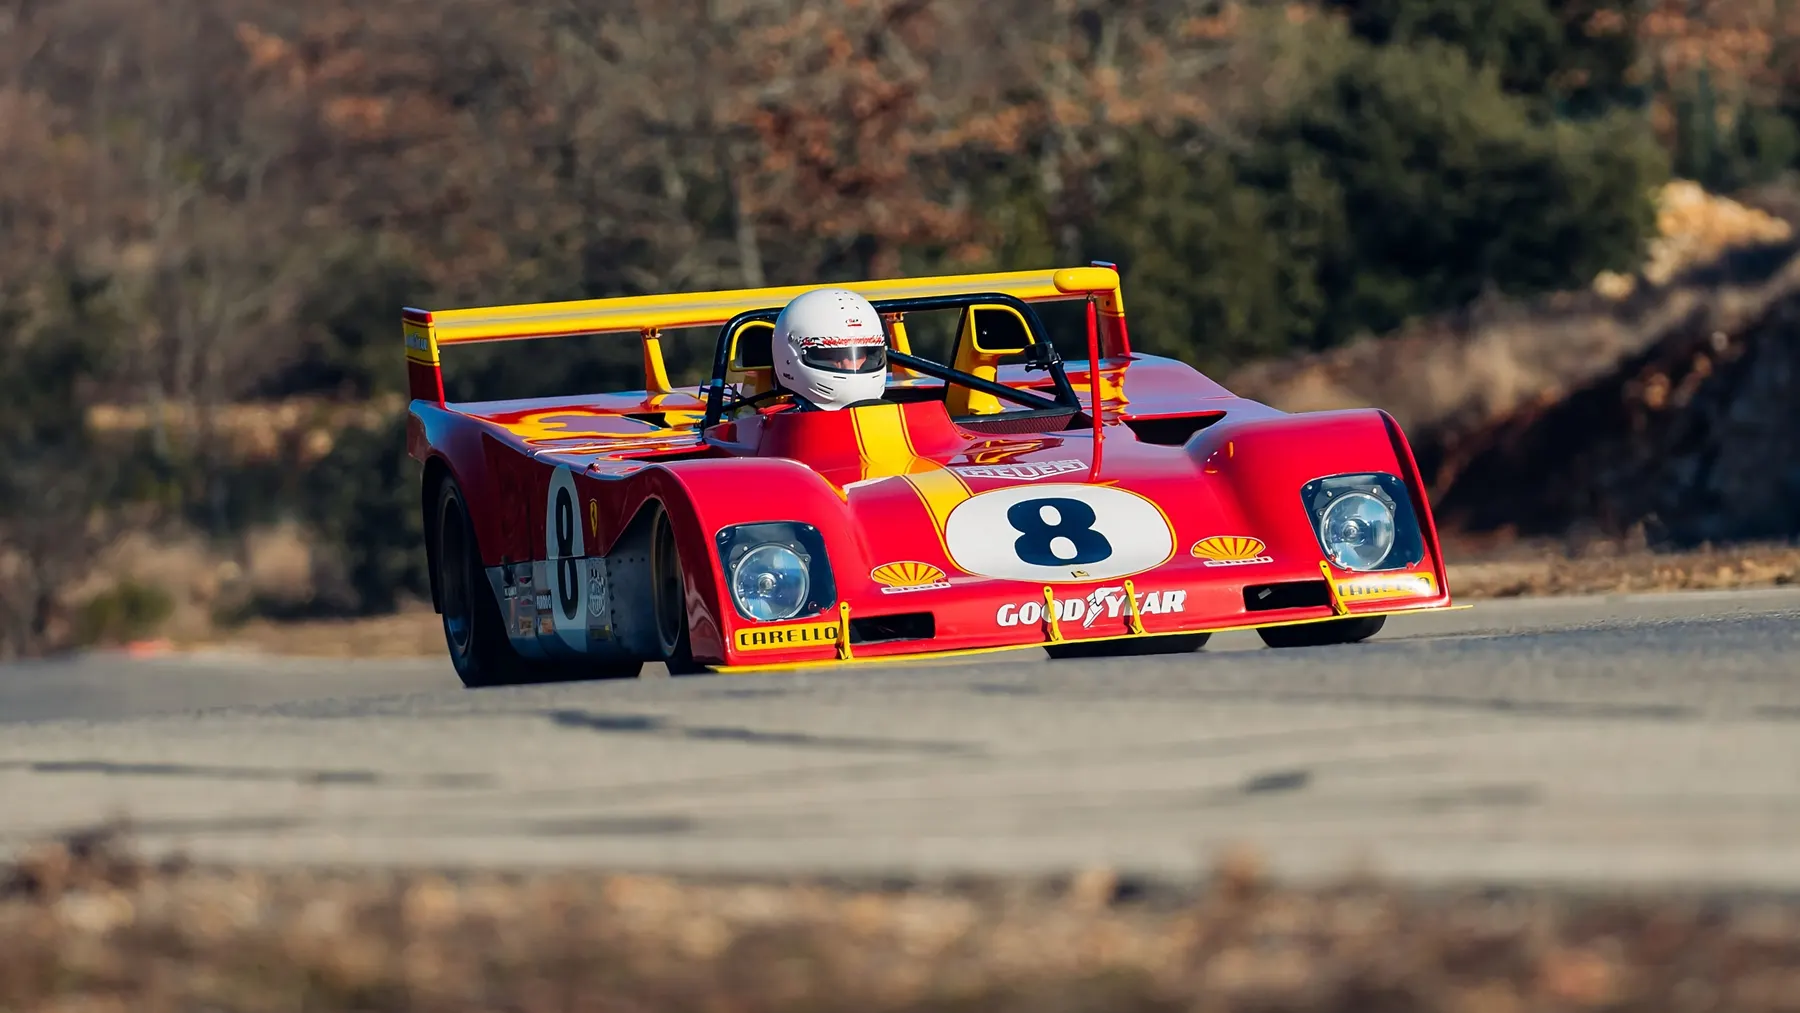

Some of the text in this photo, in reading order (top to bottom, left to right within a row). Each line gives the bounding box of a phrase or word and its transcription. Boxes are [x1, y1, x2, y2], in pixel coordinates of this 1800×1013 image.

[555, 486, 579, 620] 8
[1007, 497, 1113, 567] 8
[1338, 577, 1431, 598] CARO
[740, 626, 839, 646] CARELLO
